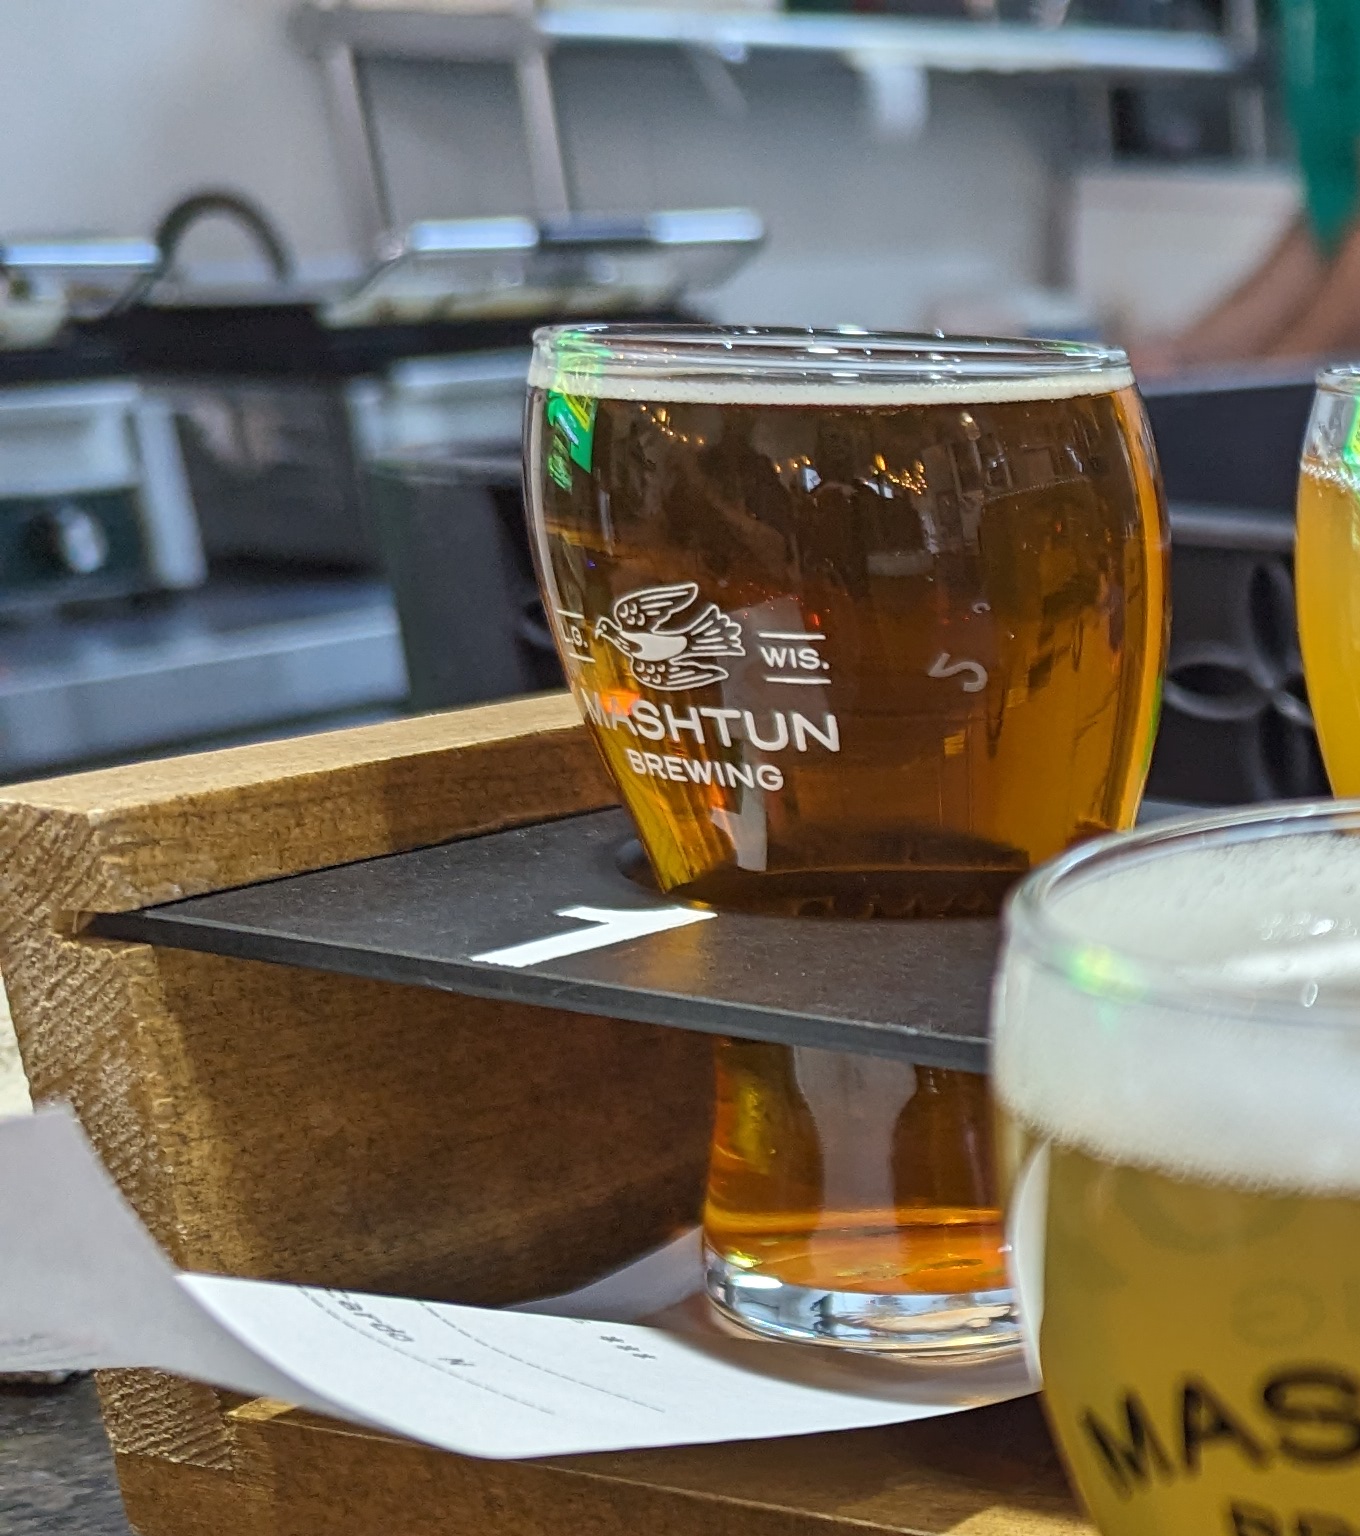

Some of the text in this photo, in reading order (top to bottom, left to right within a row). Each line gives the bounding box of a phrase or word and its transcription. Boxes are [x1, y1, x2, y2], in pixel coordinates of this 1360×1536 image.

[760, 646, 830, 670] WIS.
[581, 687, 840, 752] MASHTUN
[626, 748, 784, 792] BREWING
[468, 905, 718, 968] 1
